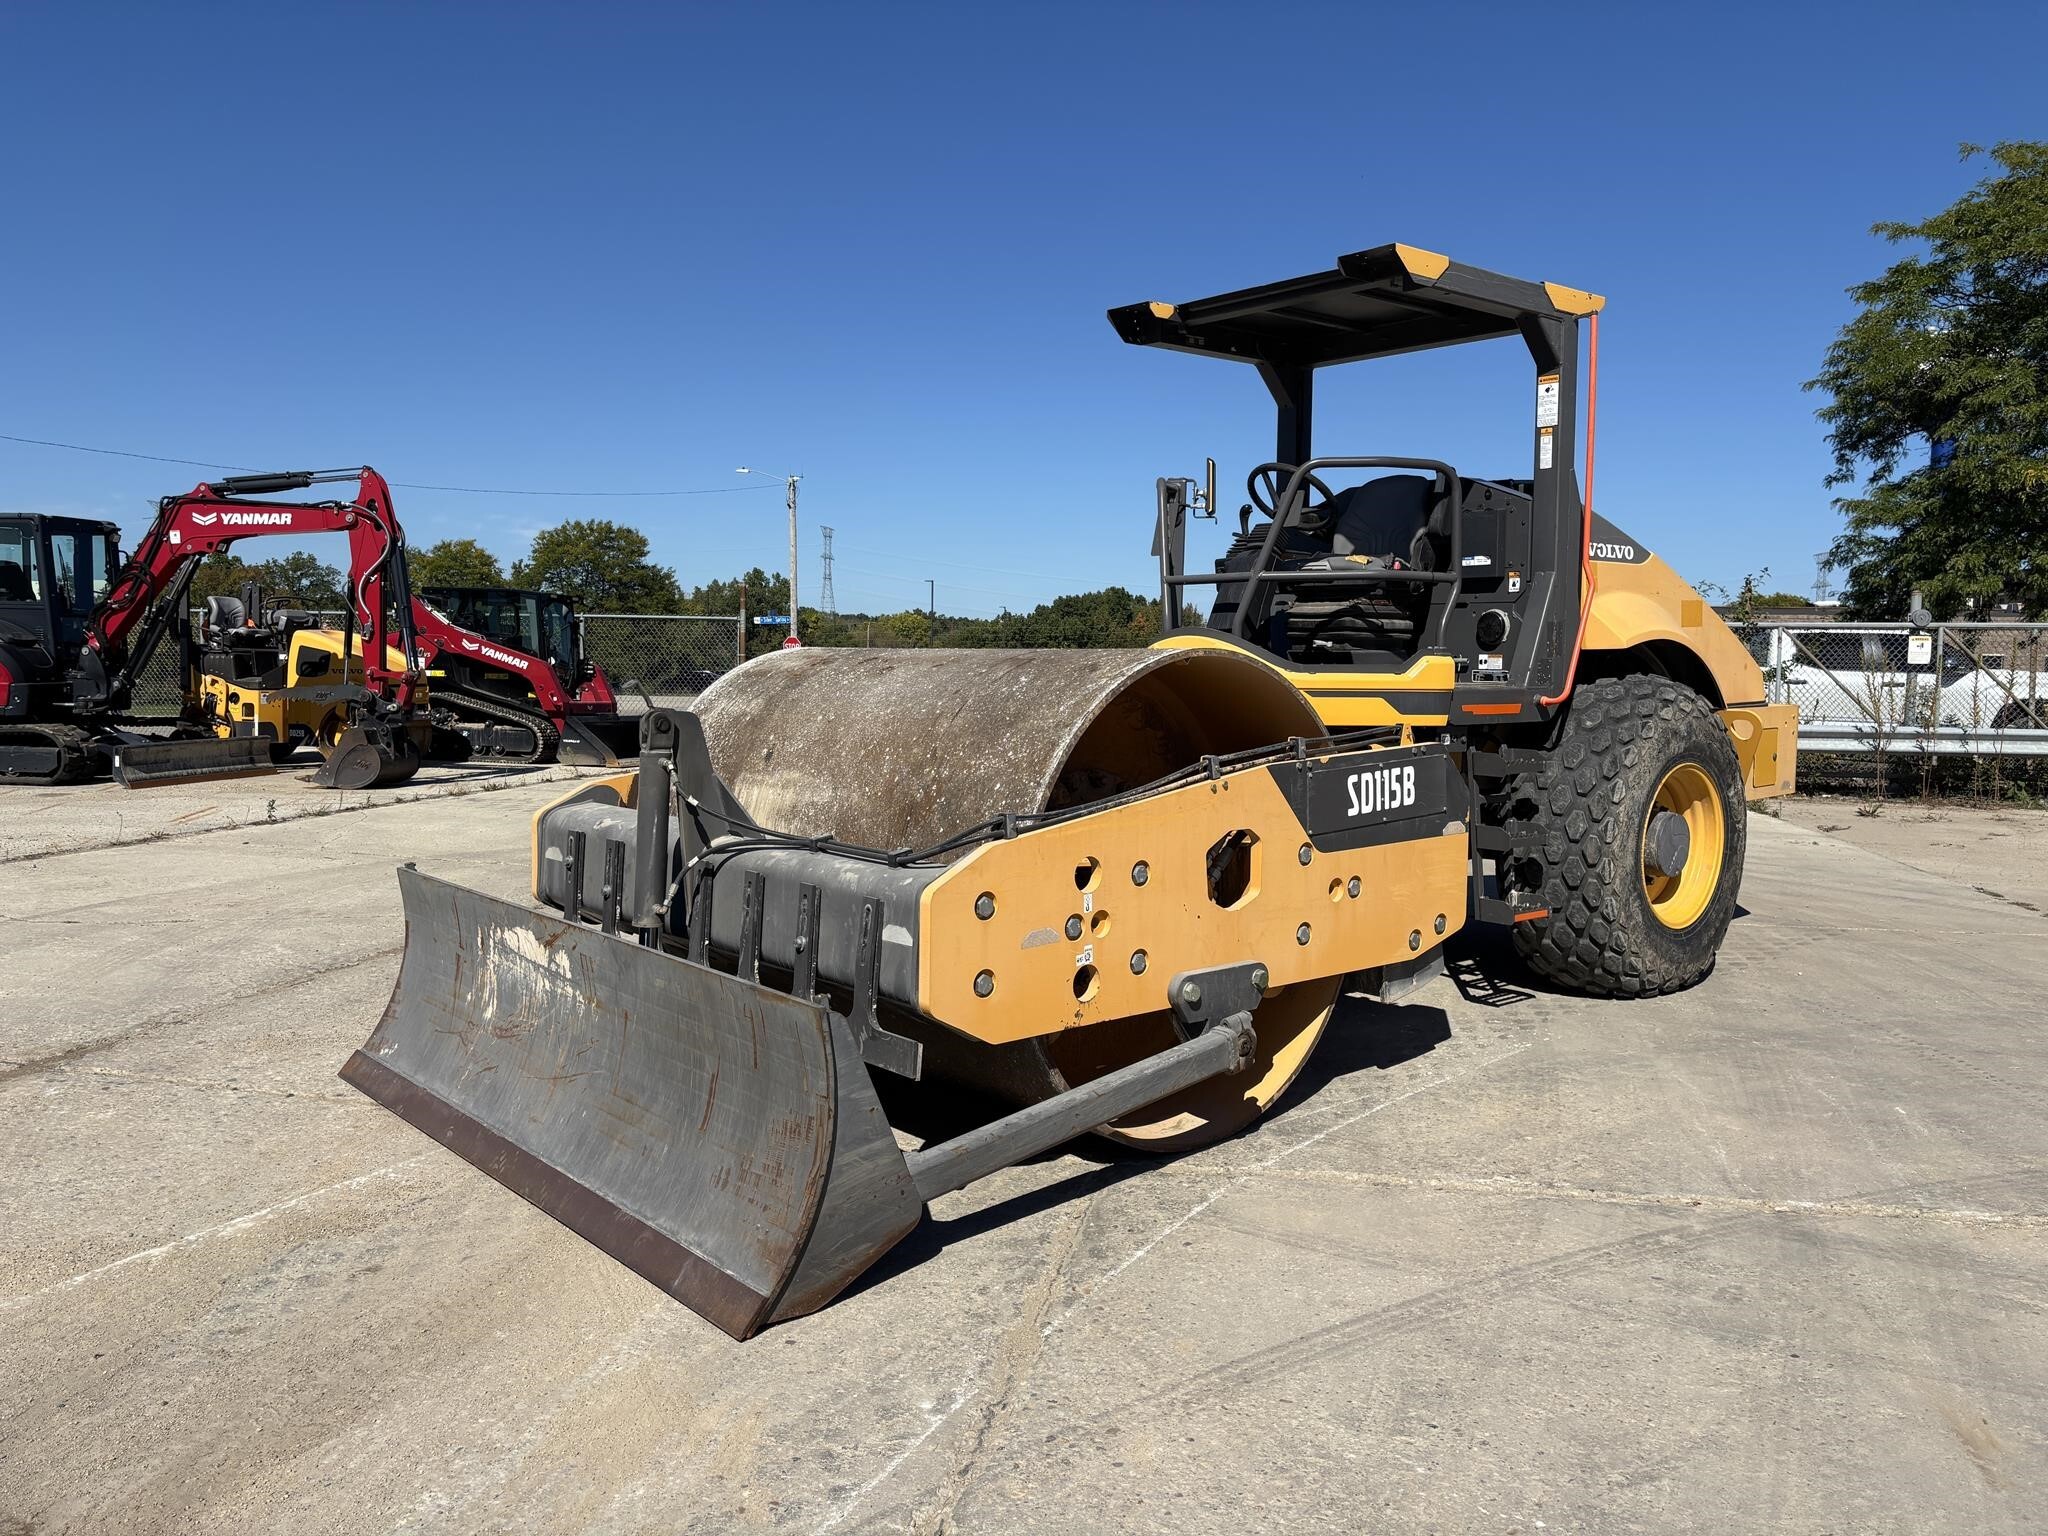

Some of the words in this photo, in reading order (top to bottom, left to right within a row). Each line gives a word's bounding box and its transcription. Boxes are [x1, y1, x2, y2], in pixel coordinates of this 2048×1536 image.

[220, 512, 292, 525] YANMAR
[1589, 542, 1634, 560] VOLVO
[480, 645, 529, 670] YANMAR
[1347, 766, 1415, 817] SD115B
